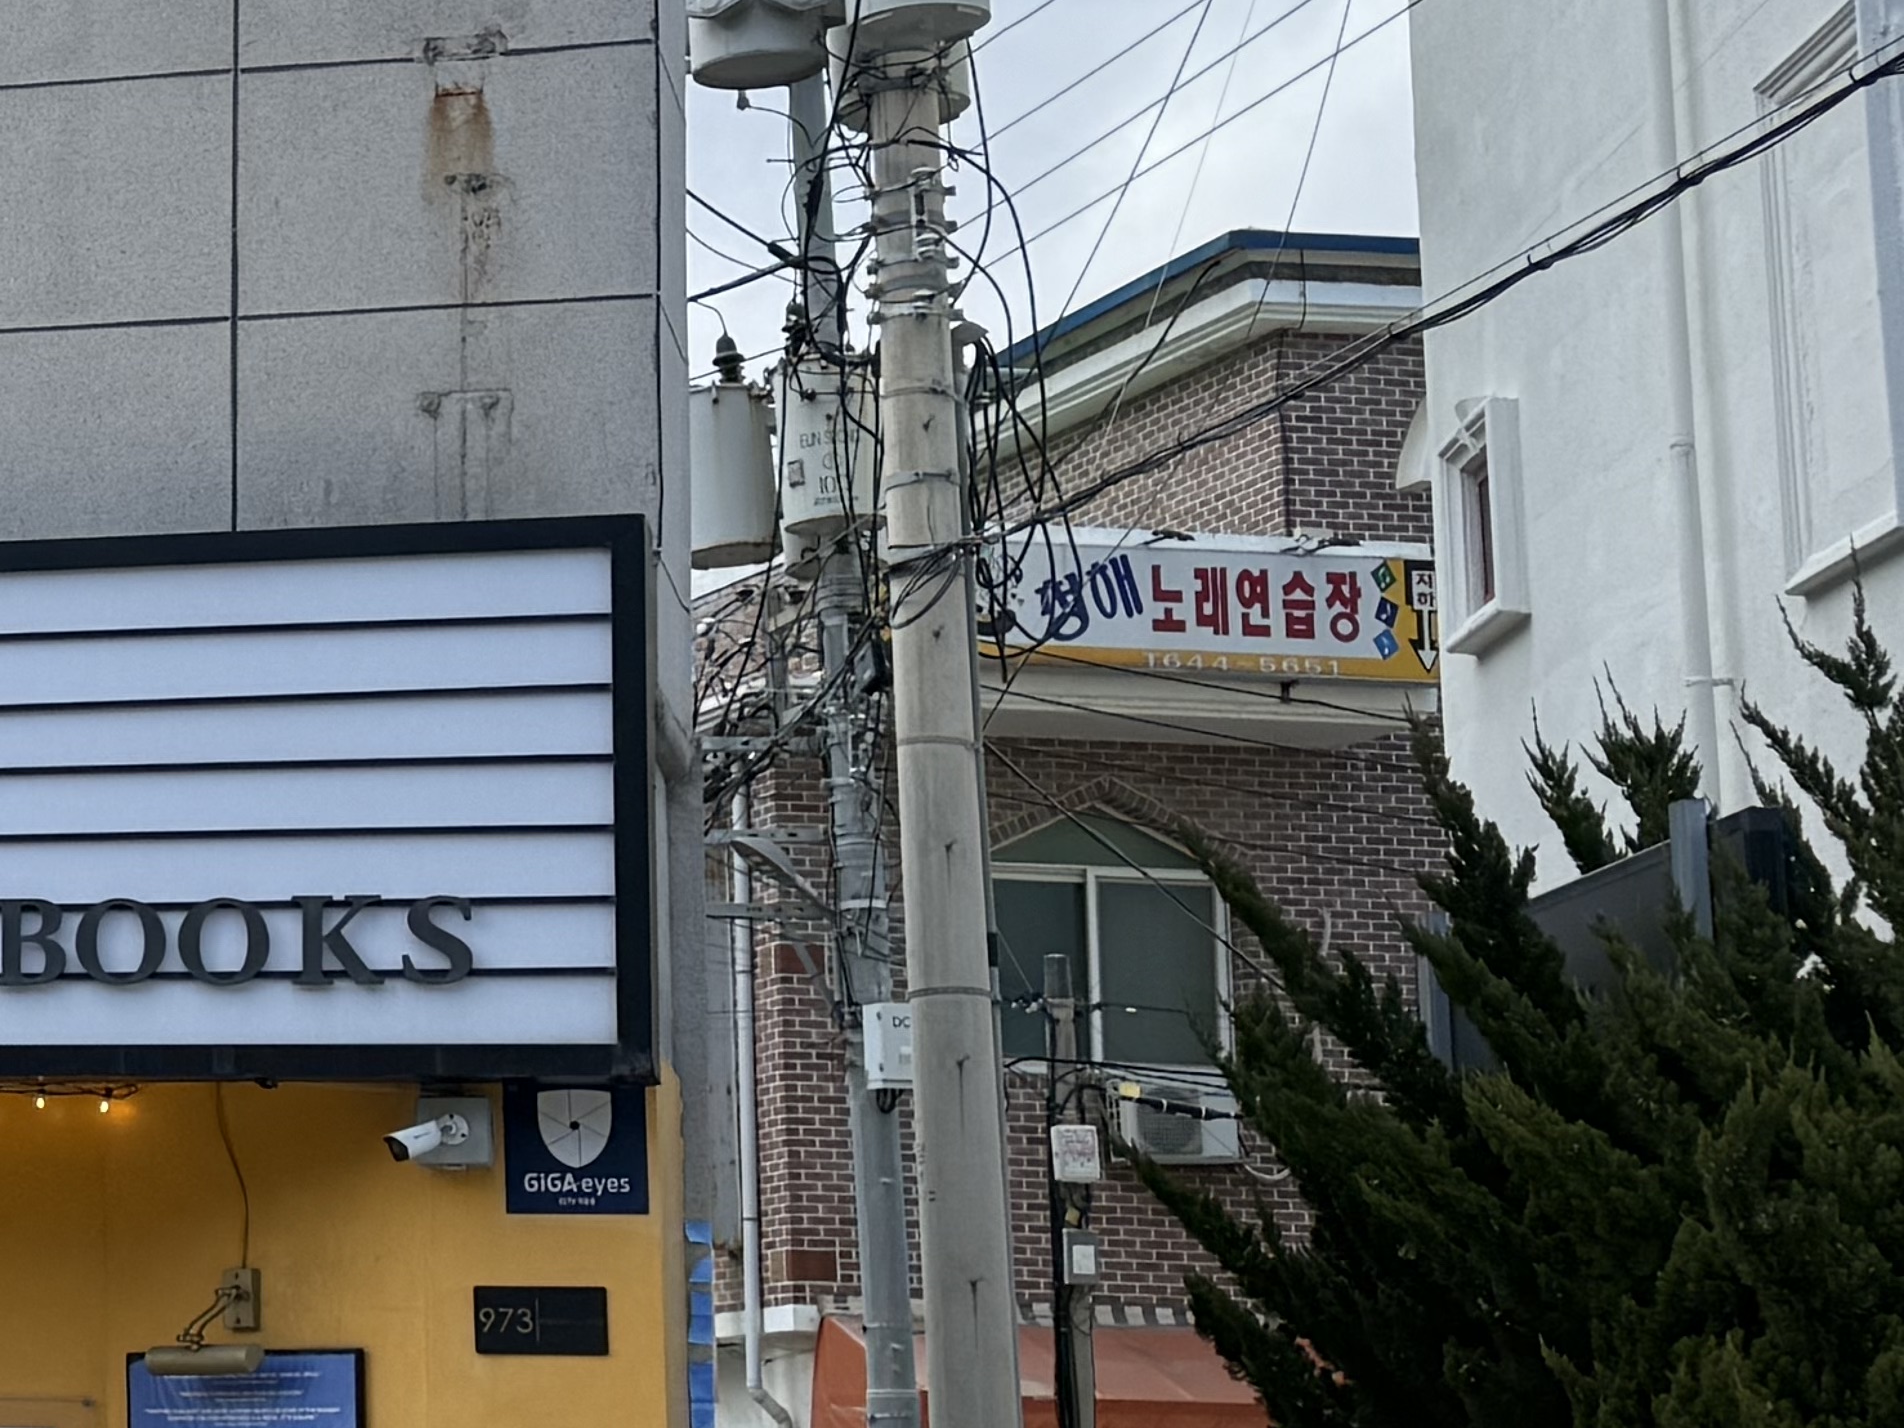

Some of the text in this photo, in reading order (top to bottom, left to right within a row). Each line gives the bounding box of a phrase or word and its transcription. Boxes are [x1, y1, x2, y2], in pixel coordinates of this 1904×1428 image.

[1151, 564, 1362, 643] 노래연습장
[1415, 572, 1435, 608] 지하
[478, 1308, 534, 1334] 973
